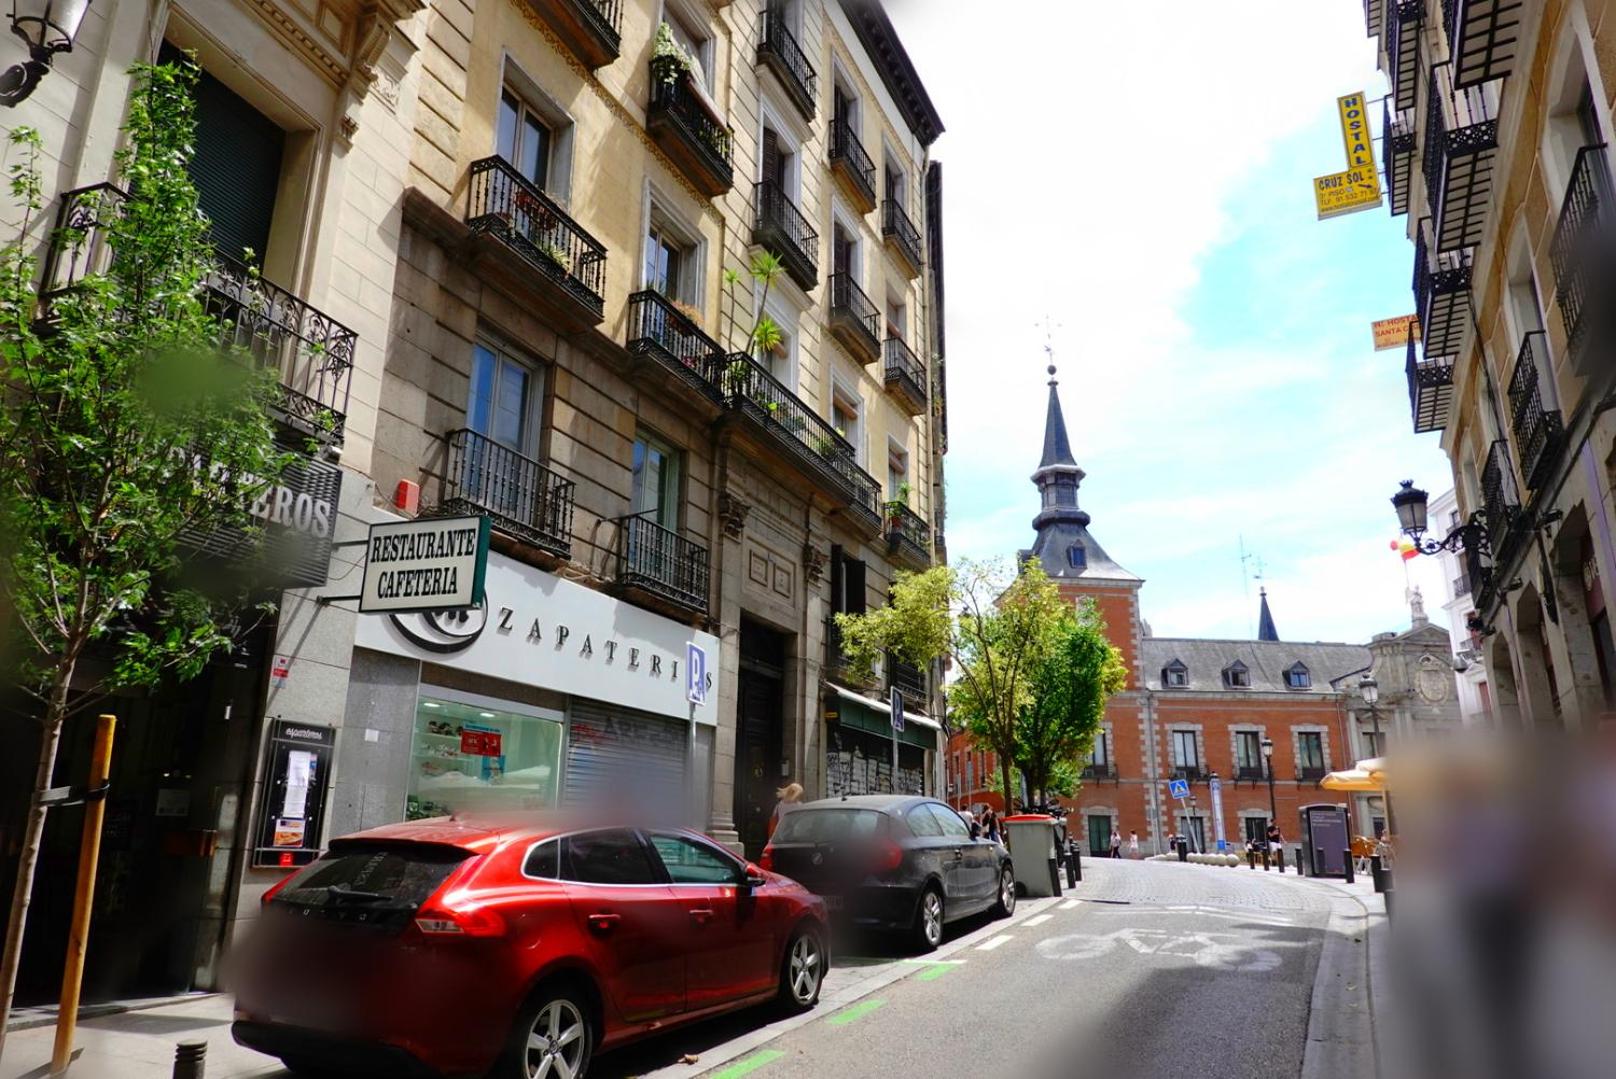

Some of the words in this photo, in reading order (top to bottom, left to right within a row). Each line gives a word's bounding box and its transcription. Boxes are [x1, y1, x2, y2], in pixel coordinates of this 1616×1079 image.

[1344, 97, 1366, 164] HOSTAL
[1319, 176, 1343, 190] CRUZ
[1346, 171, 1364, 184] SOL
[1375, 327, 1401, 336] SANTA
[370, 528, 476, 563] RESTAURANTE
[377, 566, 458, 599] CAFETERIA
[499, 606, 712, 690] ZAPATERIS
